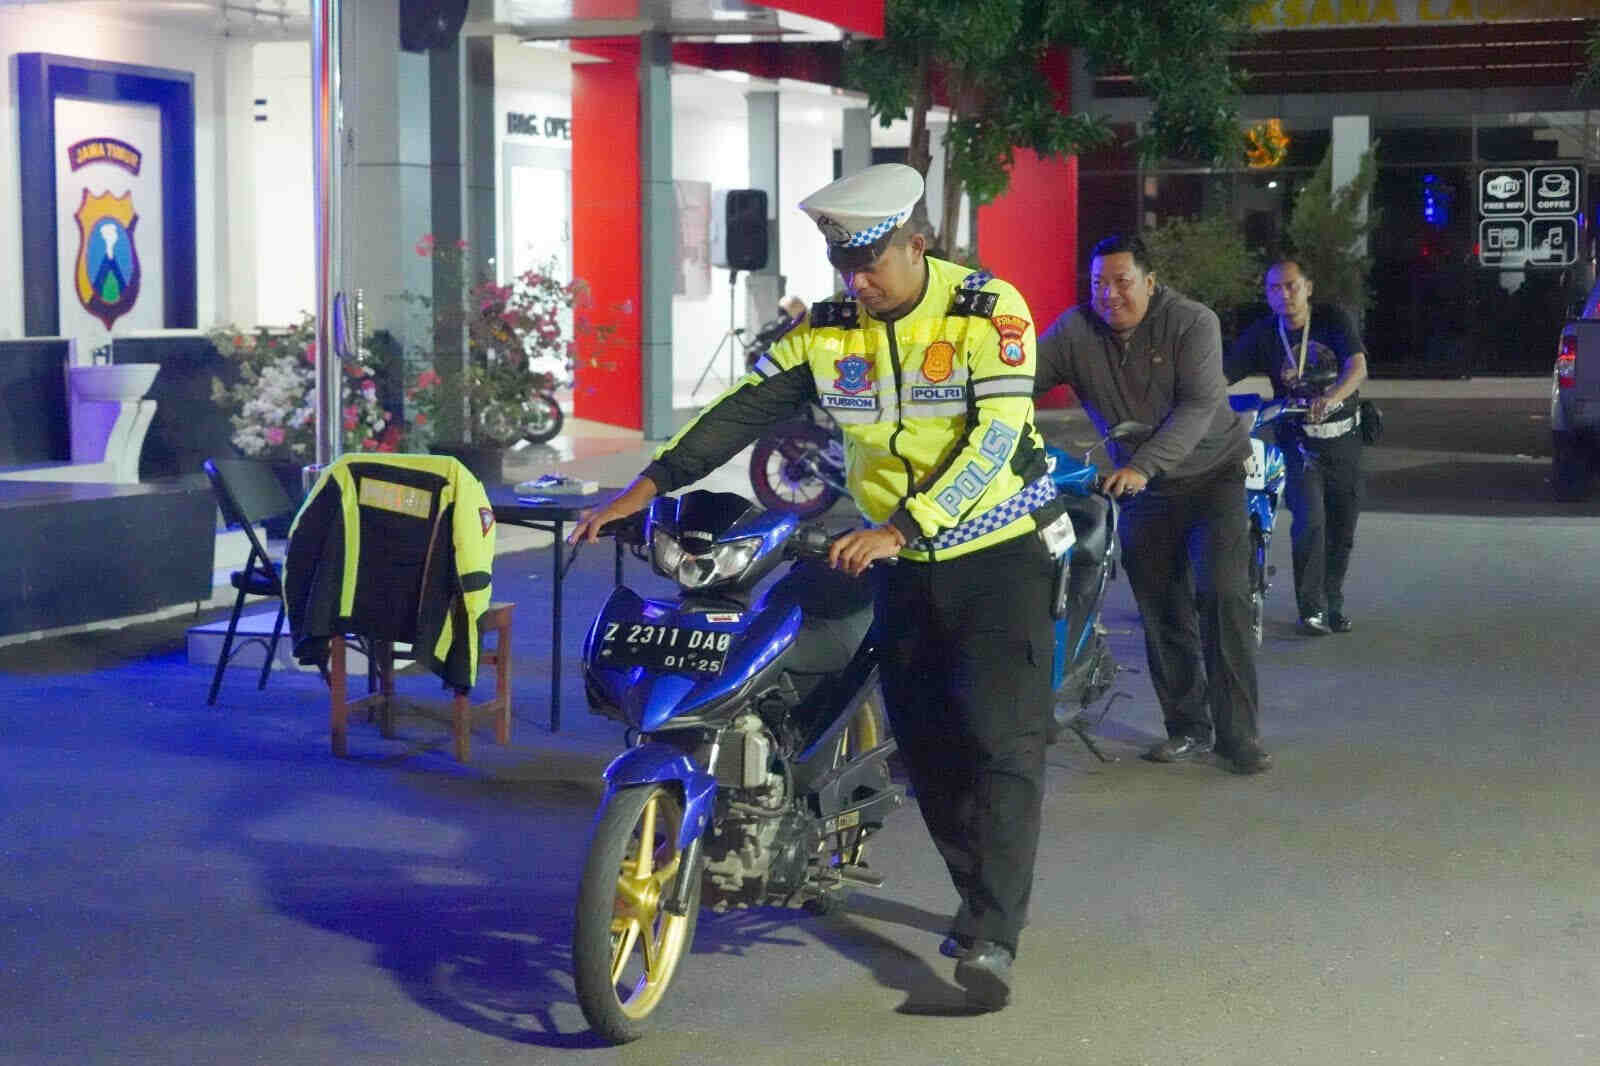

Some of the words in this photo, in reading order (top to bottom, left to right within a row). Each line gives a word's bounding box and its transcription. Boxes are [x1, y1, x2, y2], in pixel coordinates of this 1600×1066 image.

[1537, 201, 1570, 209] COFFEE
[914, 388, 960, 399] POLRI
[935, 418, 1018, 517] POLISI
[603, 622, 619, 641] Z
[627, 625, 679, 647] 2311
